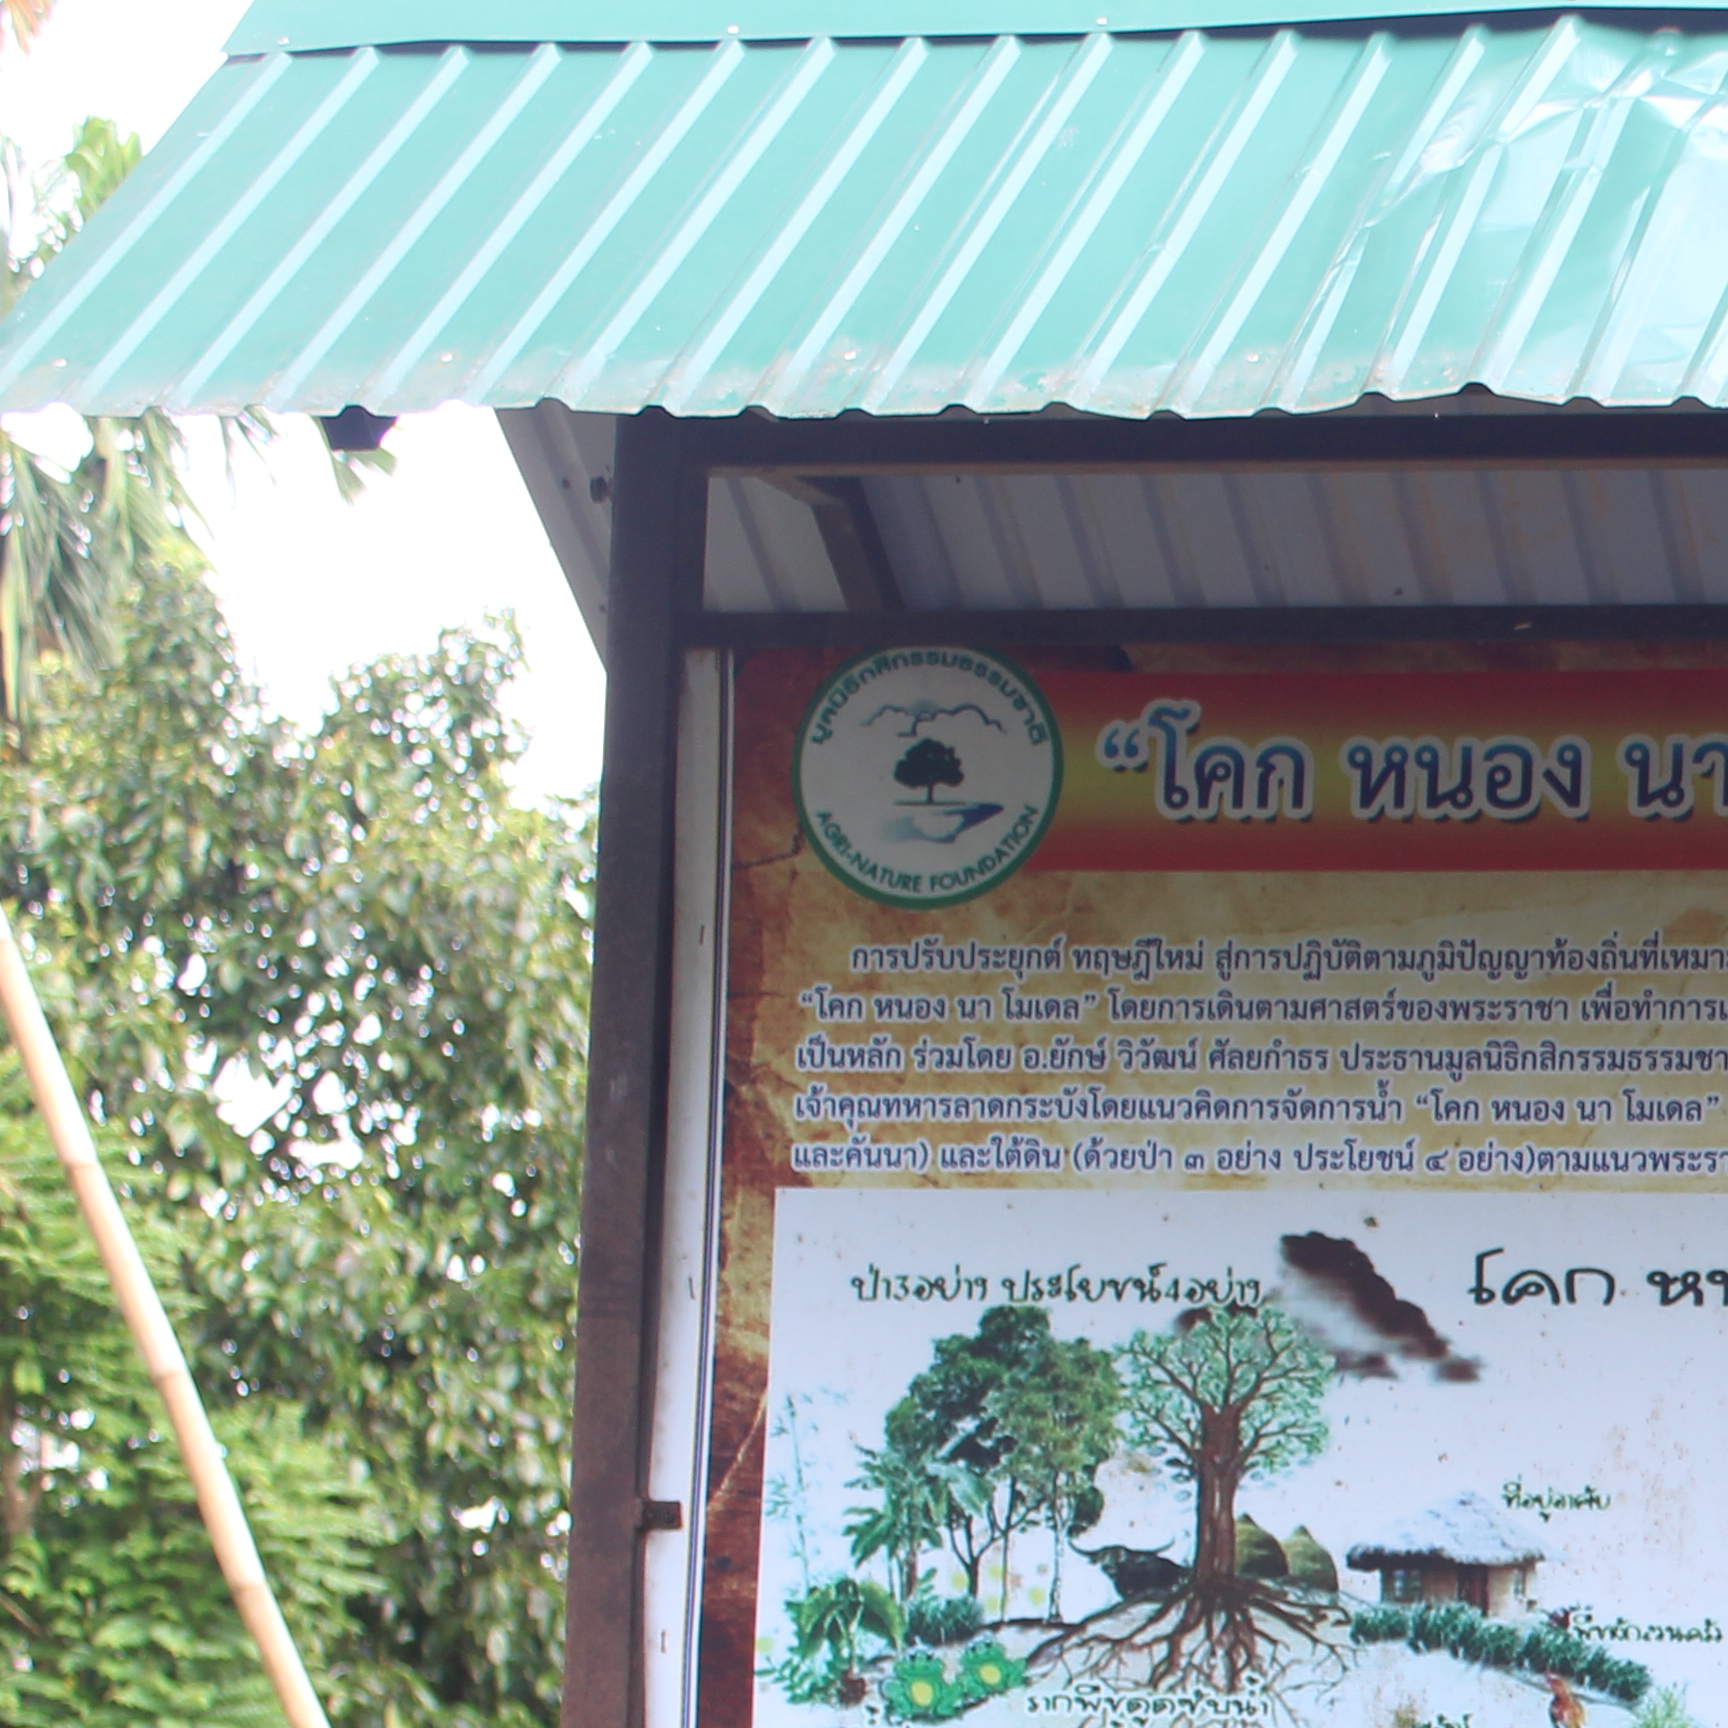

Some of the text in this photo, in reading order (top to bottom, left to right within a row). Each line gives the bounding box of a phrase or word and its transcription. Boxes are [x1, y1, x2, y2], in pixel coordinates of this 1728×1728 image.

[1098, 702, 1312, 818] “โคก
[1345, 730, 1592, 820] หนอง
[816, 805, 1038, 893] AGRI-NATURE FOUNDATION
[851, 934, 1062, 980] การปรับประยุกต์
[799, 988, 863, 1020] “โคก
[874, 994, 945, 1021] หนอง
[956, 994, 992, 1020] นา
[1000, 988, 1096, 1021] โมเดล”
[1106, 988, 1569, 1022] โดยการเดินตามศาสตร์ของพระราชา
[796, 1034, 902, 1071] เป็นหลัก
[913, 1036, 1012, 1071] ร่วมโดย
[1022, 1037, 1107, 1071] อ.ยักษ์
[1117, 1037, 1197, 1070] วิวัฒน์
[1208, 1040, 1329, 1071] ศัลยกำธร
[794, 1081, 1403, 1129] เจ้าคุณทหารลาดกระบังโดยแนวคิดการจัดการน้ำ
[1416, 1089, 1479, 1122] “โคก
[1490, 1095, 1565, 1123] หนอง
[1576, 1095, 1613, 1122] นา
[1622, 1090, 1719, 1122] โมเดล”
[792, 1135, 929, 1174] และคันนา)
[940, 1135, 1061, 1171] และใต้ดิน
[1072, 1135, 1173, 1173] (ด้วยป่า
[1216, 1140, 1281, 1171] อย่าง
[1293, 1137, 1415, 1172] ประโยชน์
[1467, 1248, 1616, 1309] โคก
